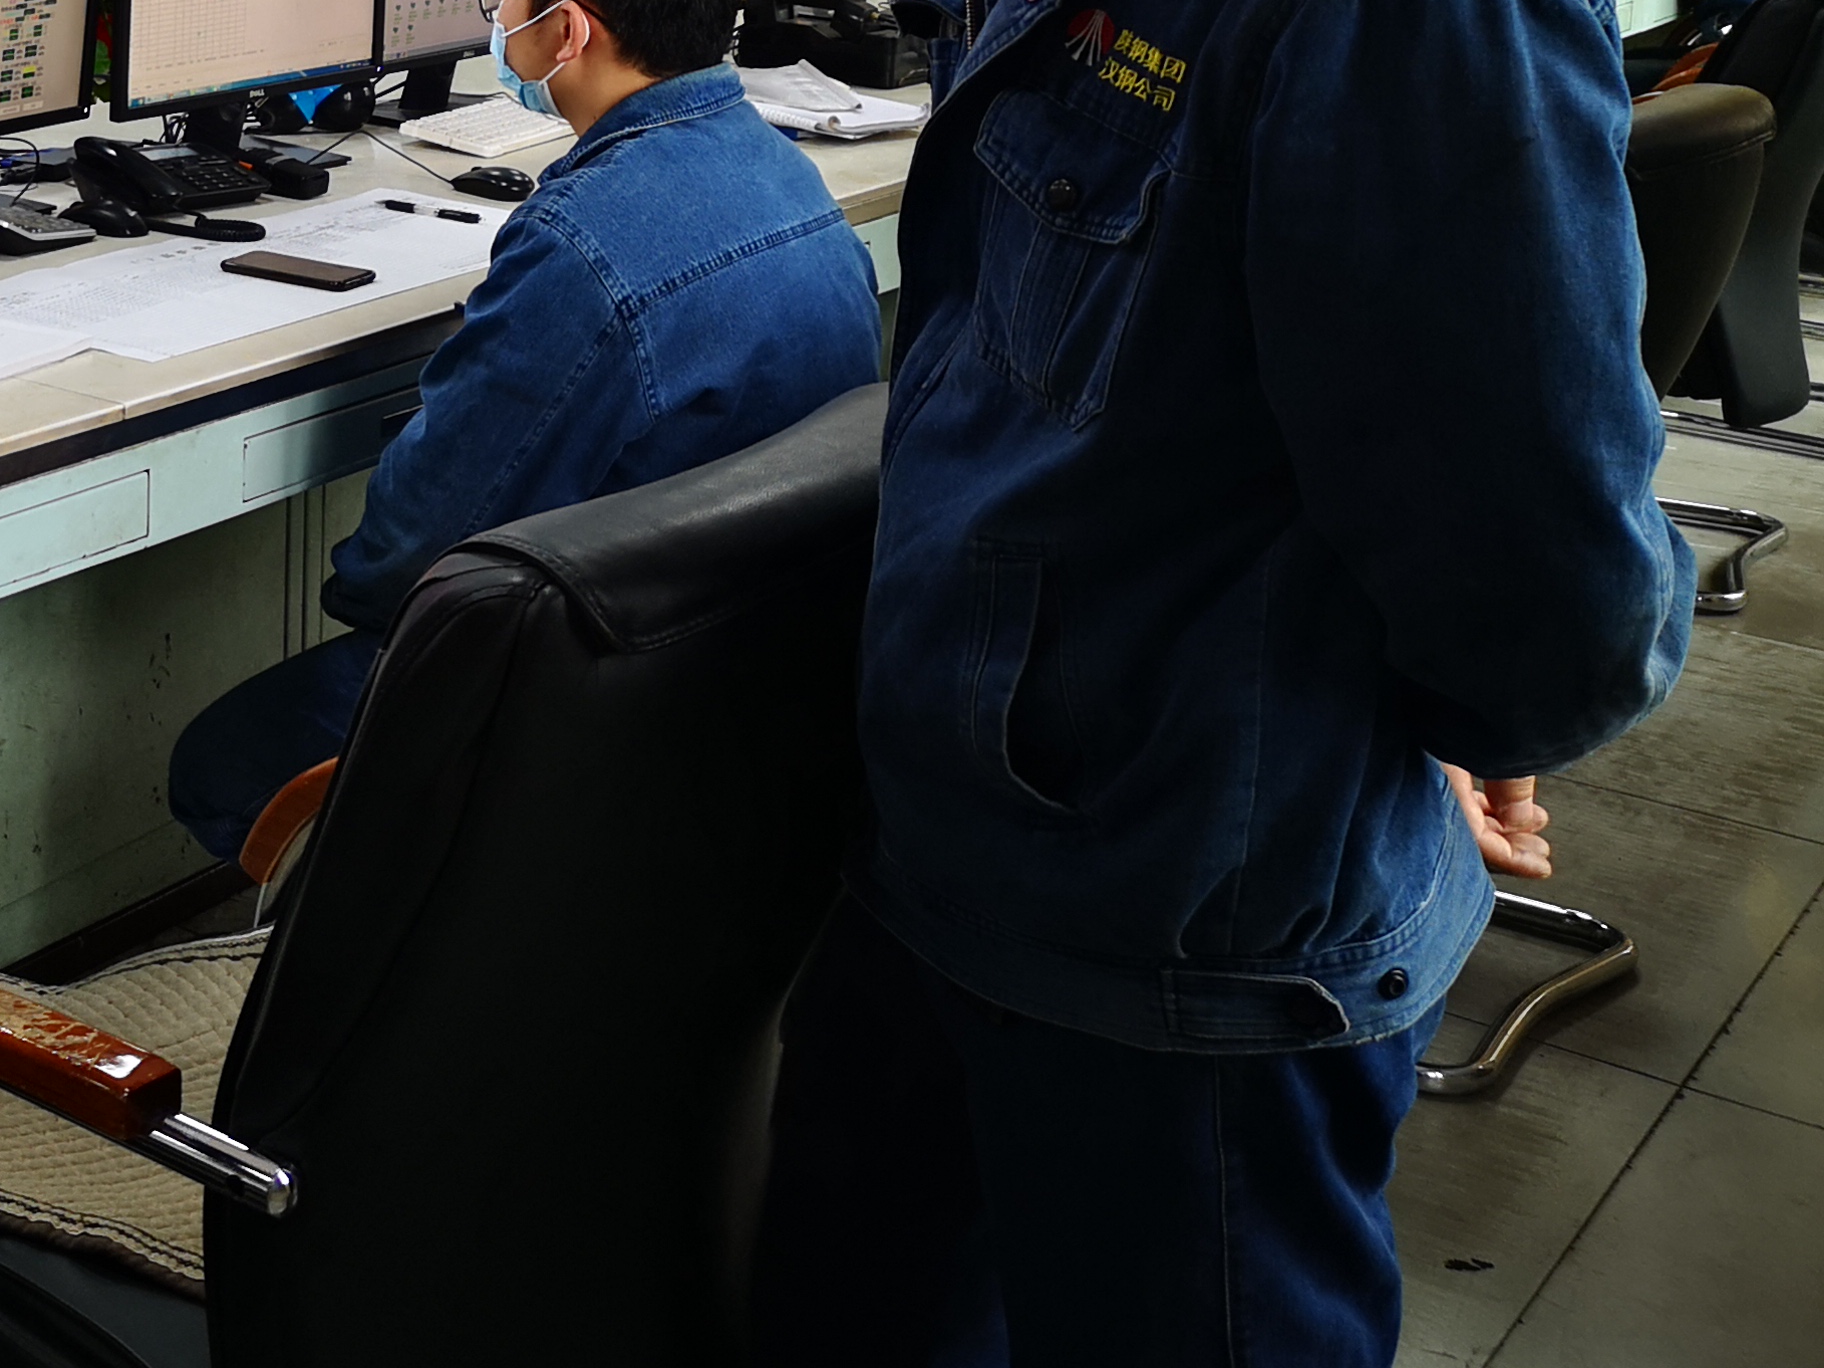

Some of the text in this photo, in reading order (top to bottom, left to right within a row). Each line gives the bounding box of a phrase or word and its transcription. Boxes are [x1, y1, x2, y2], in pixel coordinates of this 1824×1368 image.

[1098, 56, 1176, 112] 汉钢公司
[1113, 29, 1188, 84] 陕钢集团
